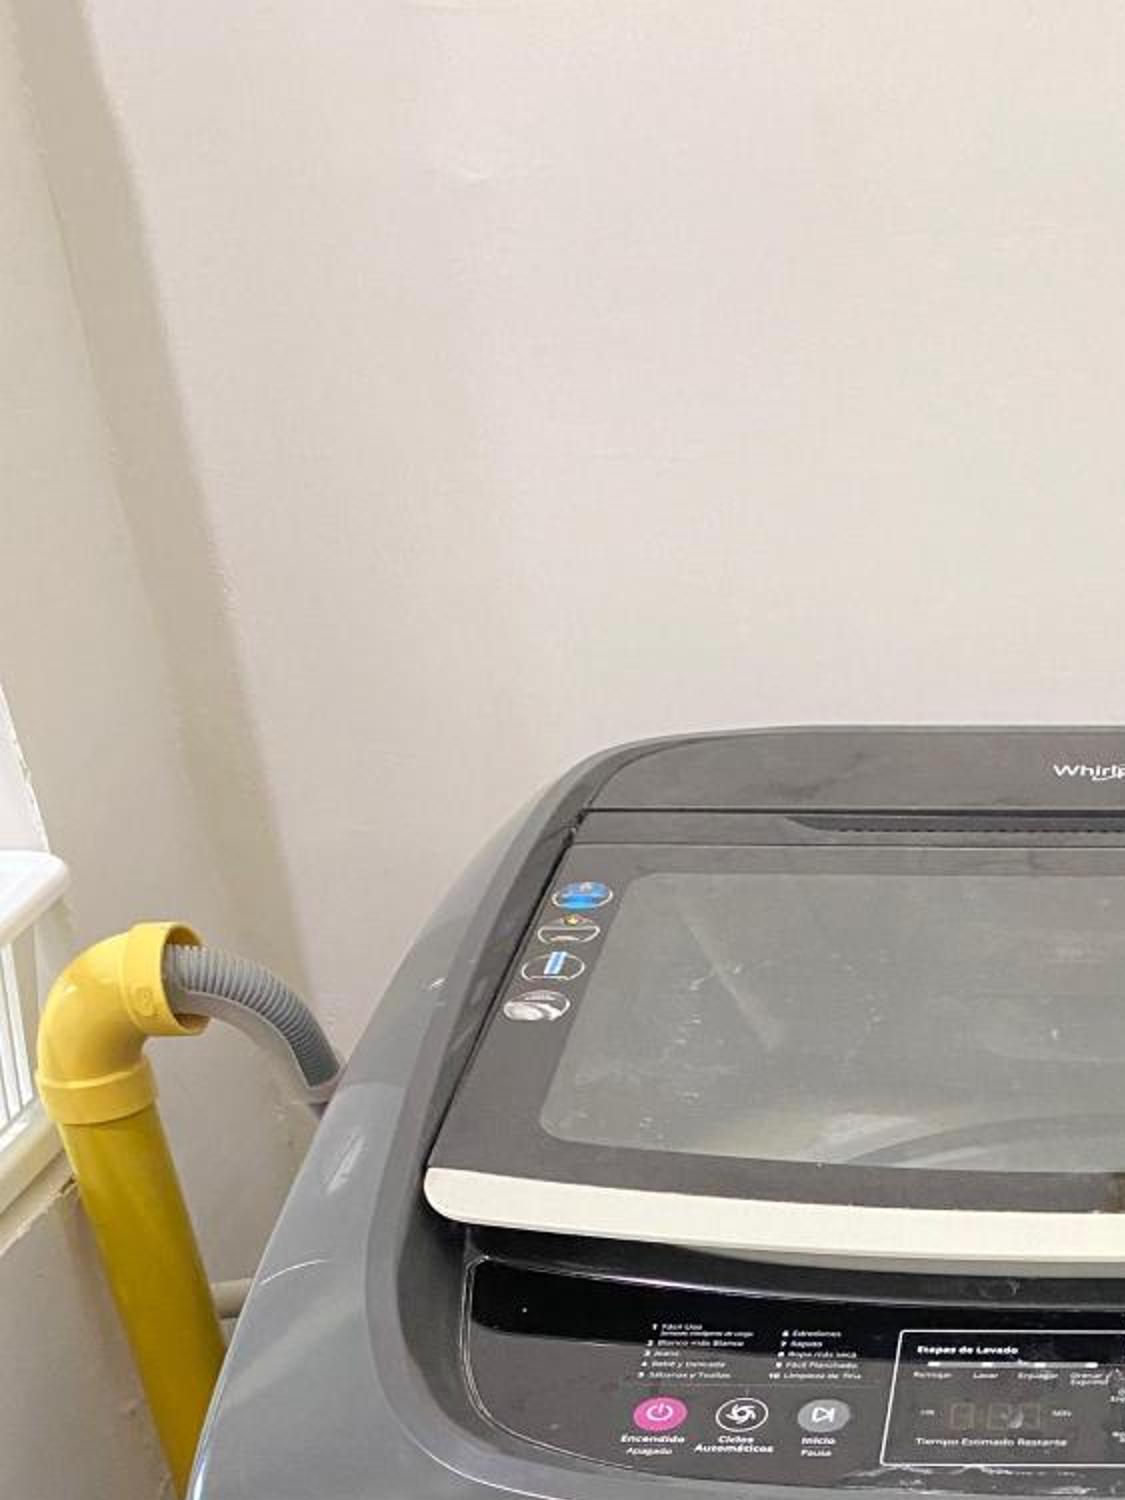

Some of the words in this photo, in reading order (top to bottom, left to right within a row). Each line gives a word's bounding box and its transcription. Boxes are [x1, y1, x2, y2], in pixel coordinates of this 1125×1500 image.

[916, 1345, 956, 1355] Etapas
[958, 1346, 974, 1354] de
[975, 1346, 1019, 1355] Lavado
[620, 1434, 686, 1444] Encendido
[717, 1435, 755, 1444] Ciclos
[800, 1436, 837, 1445] Inicio
[916, 1437, 959, 1447] Tiempo
[961, 1438, 1015, 1446] Estimado
[1017, 1438, 1068, 1447] Restante
[626, 1447, 673, 1456] Apagado
[694, 1443, 774, 1454] Automáticos
[800, 1448, 832, 1457] Pausa
